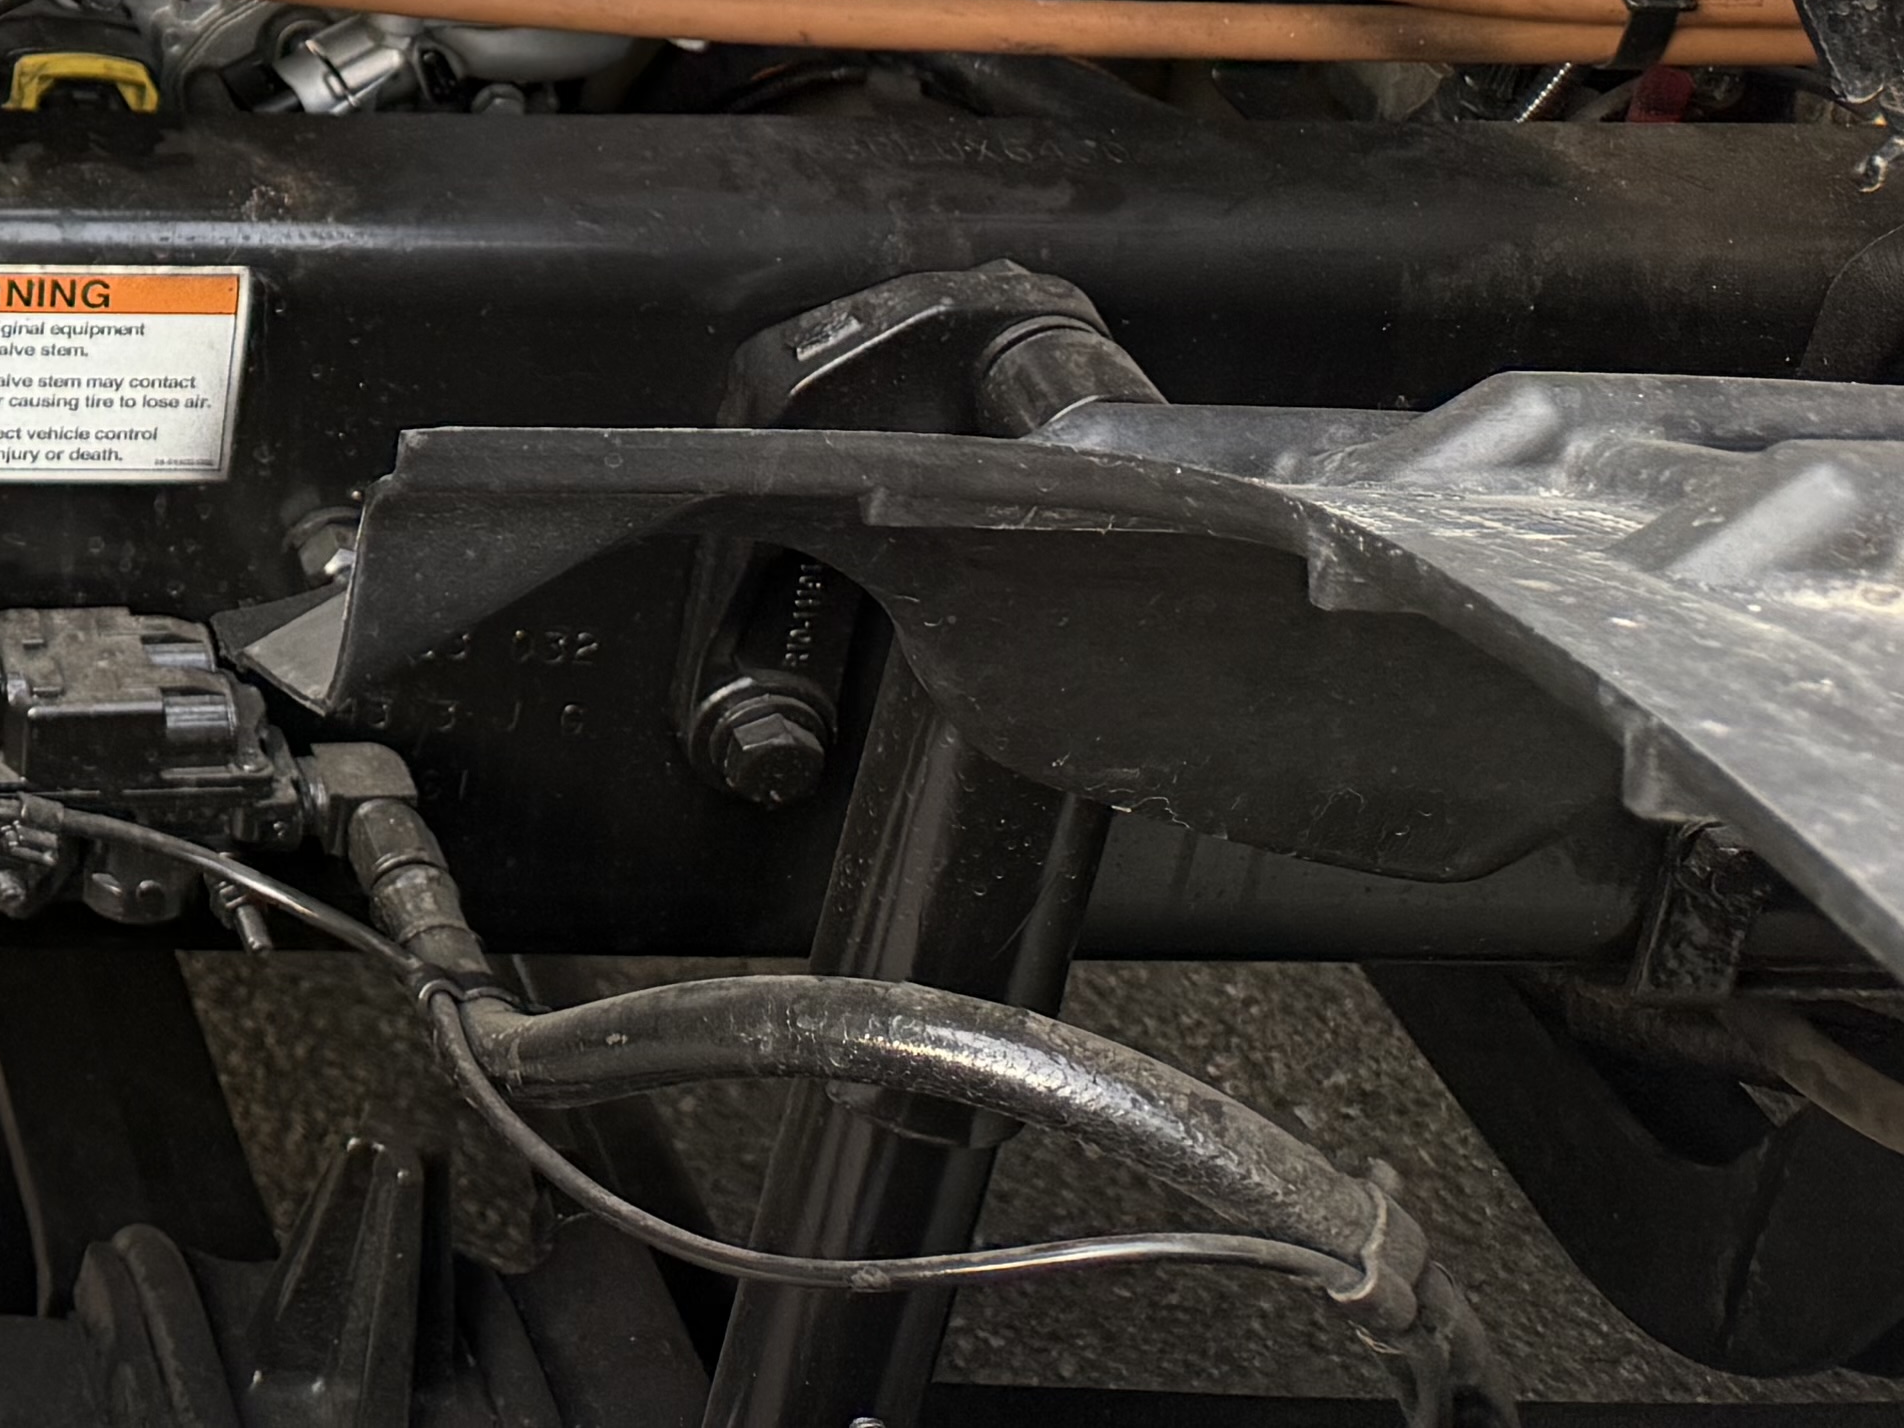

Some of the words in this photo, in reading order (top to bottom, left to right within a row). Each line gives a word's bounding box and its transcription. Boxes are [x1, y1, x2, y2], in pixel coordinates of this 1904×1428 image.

[49, 323, 145, 339] equipment
[41, 344, 89, 358] stem.
[38, 376, 81, 390] stem
[85, 378, 124, 393] may
[126, 375, 196, 390] contact
[8, 394, 79, 413] causing
[84, 395, 115, 409] tire
[119, 396, 137, 409] to
[142, 395, 180, 410] lose
[184, 397, 212, 410] air.
[26, 426, 91, 441] vehicle
[95, 427, 158, 442] control
[45, 449, 64, 463] or
[69, 447, 123, 463] death.
